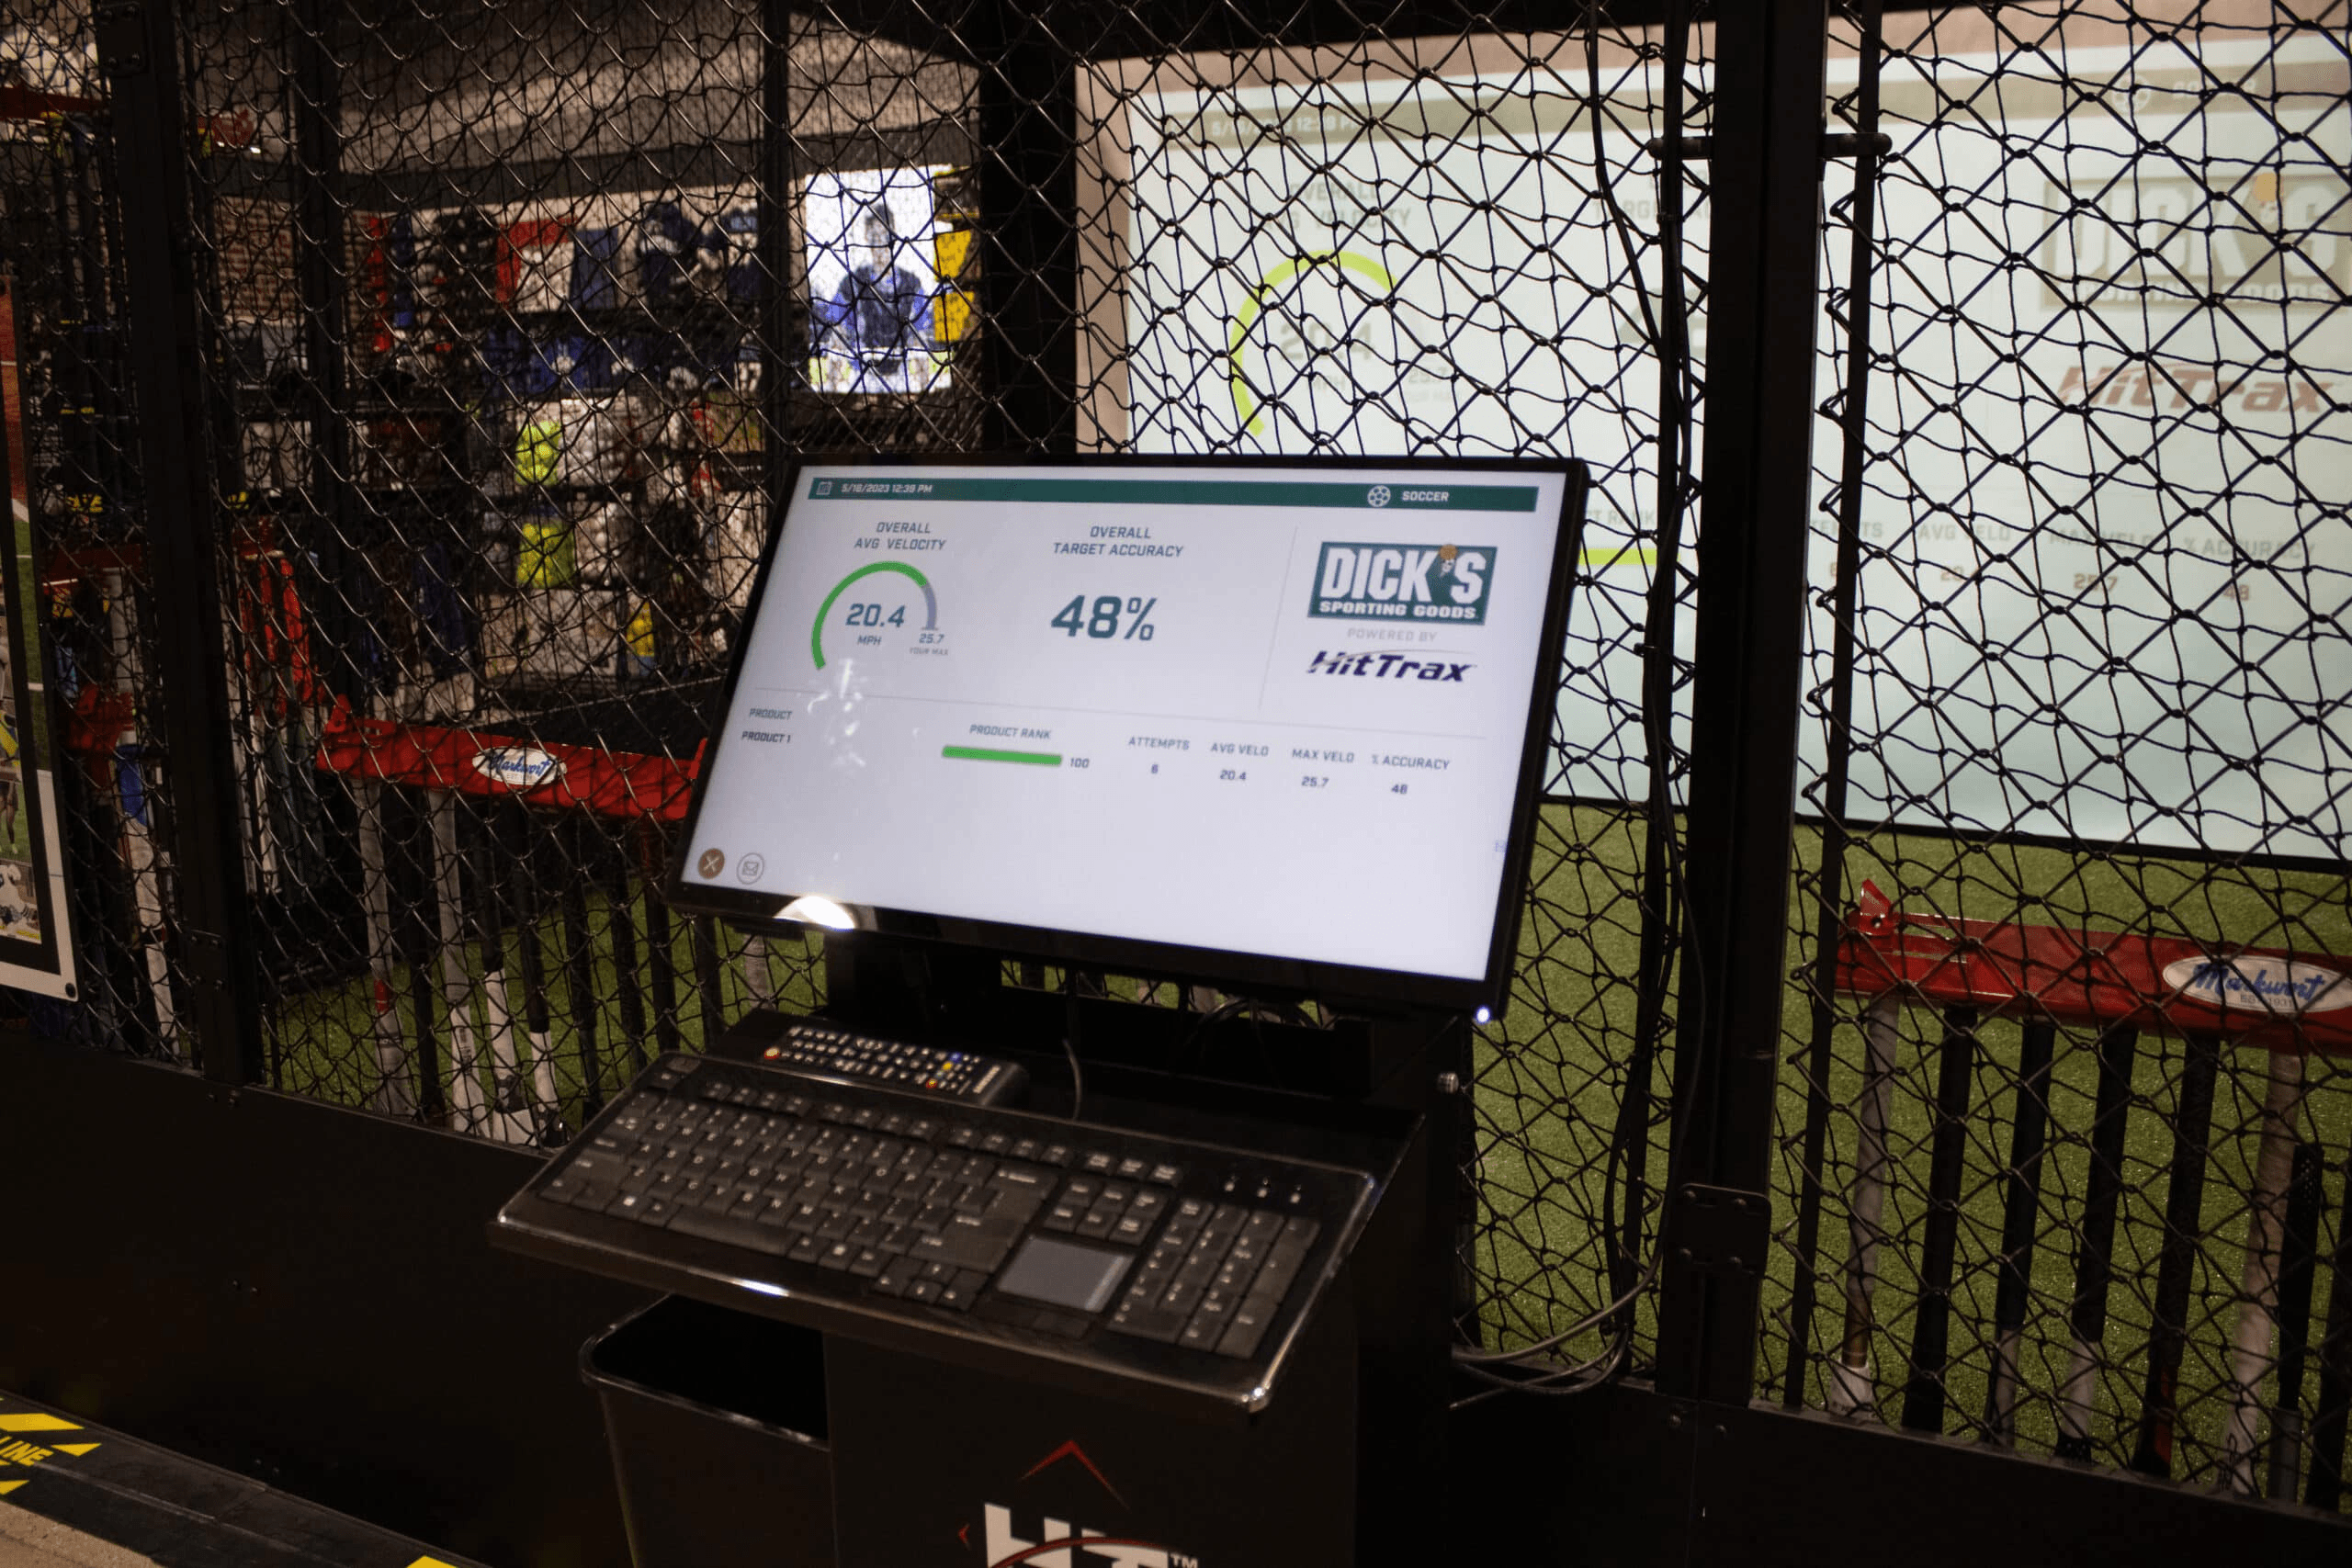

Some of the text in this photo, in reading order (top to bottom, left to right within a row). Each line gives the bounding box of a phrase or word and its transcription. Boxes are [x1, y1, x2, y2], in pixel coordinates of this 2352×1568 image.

[917, 484, 933, 493] PM
[1402, 491, 1450, 502] SOCCER
[876, 522, 931, 534] OVERALL
[1090, 525, 1151, 539] OVERALL
[854, 538, 947, 550] AVG VELOCITY
[1053, 542, 1183, 558] TARGET ACCURACY
[1320, 544, 1487, 604] DICK'S
[845, 603, 907, 628] 20.4
[1319, 601, 1476, 620] SPORTING GOODS
[1051, 595, 1158, 641] 48%
[857, 635, 882, 647] MPH
[919, 633, 944, 644] 25.7
[1347, 627, 1438, 643] POWERED BY
[1306, 649, 1476, 682] HitTrax
[749, 708, 793, 720] PRODUCT
[741, 731, 785, 743] PRODUCT
[969, 724, 1052, 740] PRODUCT RANK
[1128, 736, 1190, 751] ATTEMPTS
[1211, 742, 1270, 757] AVG VELO
[1292, 749, 1355, 763] MAX VELO
[1069, 758, 1091, 769] 100
[1382, 756, 1451, 771] ACCURACY
[1220, 770, 1247, 782] 20.4
[1301, 776, 1329, 788] 25.7
[1391, 784, 1408, 795] 48
